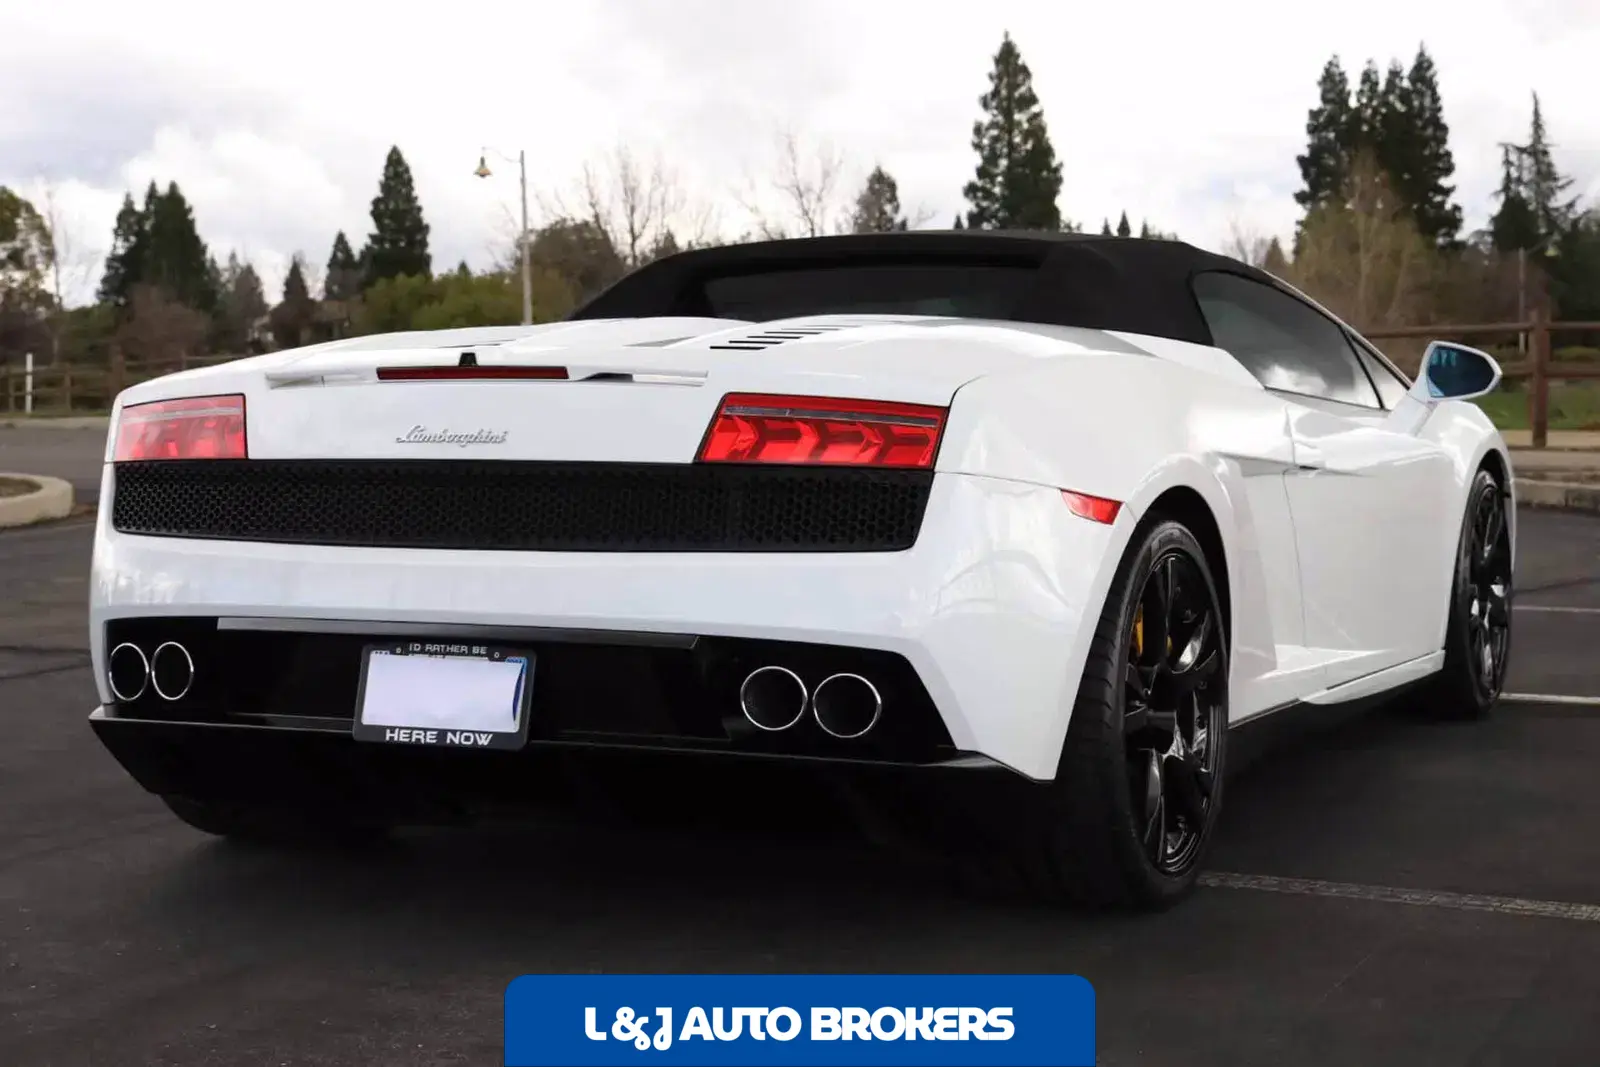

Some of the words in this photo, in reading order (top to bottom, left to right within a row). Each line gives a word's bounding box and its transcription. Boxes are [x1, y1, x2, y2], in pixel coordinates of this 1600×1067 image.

[395, 424, 508, 448] Lamborghini
[425, 643, 468, 654] RATHER
[472, 646, 488, 655] BE
[385, 728, 438, 744] HERE
[446, 731, 494, 746] NOW
